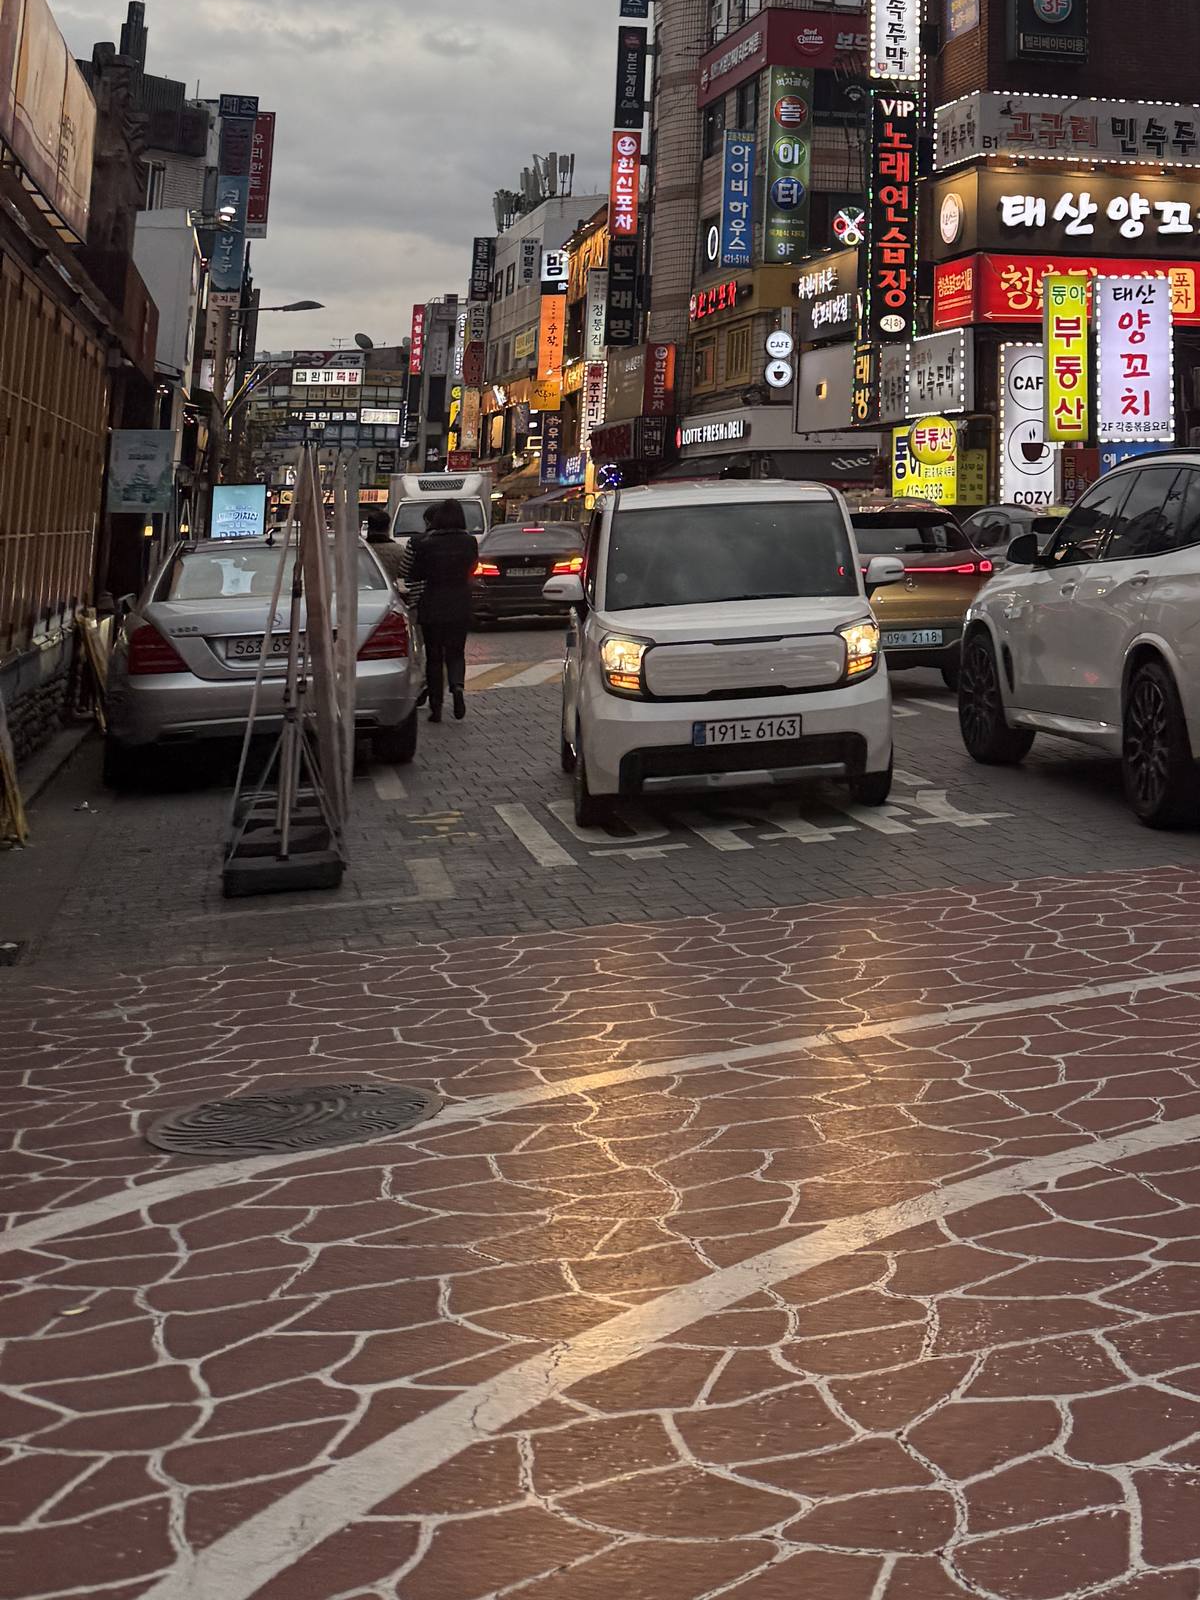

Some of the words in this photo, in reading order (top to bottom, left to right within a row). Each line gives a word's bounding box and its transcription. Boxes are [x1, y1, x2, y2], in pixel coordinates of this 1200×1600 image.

[1006, 111, 1099, 148] 고구려
[777, 101, 802, 204] 놀이터
[982, 135, 1000, 149] B1
[614, 157, 635, 232] 한신포차
[876, 121, 913, 308] 노래연습장
[612, 245, 635, 257] SKY
[777, 242, 795, 256] 3F
[1052, 284, 1086, 306] 동아
[1112, 283, 1156, 304] 태산
[1173, 271, 1192, 309] 포차
[609, 263, 634, 339] 노래방
[883, 316, 904, 331] 지하
[770, 340, 790, 349] CAFE
[1053, 314, 1086, 432] 부동산
[1117, 308, 1151, 417] 양꼬치
[1013, 376, 1043, 390] CAF
[682, 427, 702, 445] LOTTE
[1101, 422, 1114, 432] 2F
[915, 427, 953, 451] 부동산
[1014, 491, 1053, 505] COZY
[912, 631, 937, 643] 2118
[708, 724, 751, 743] 191노
[755, 719, 796, 739] 6163
